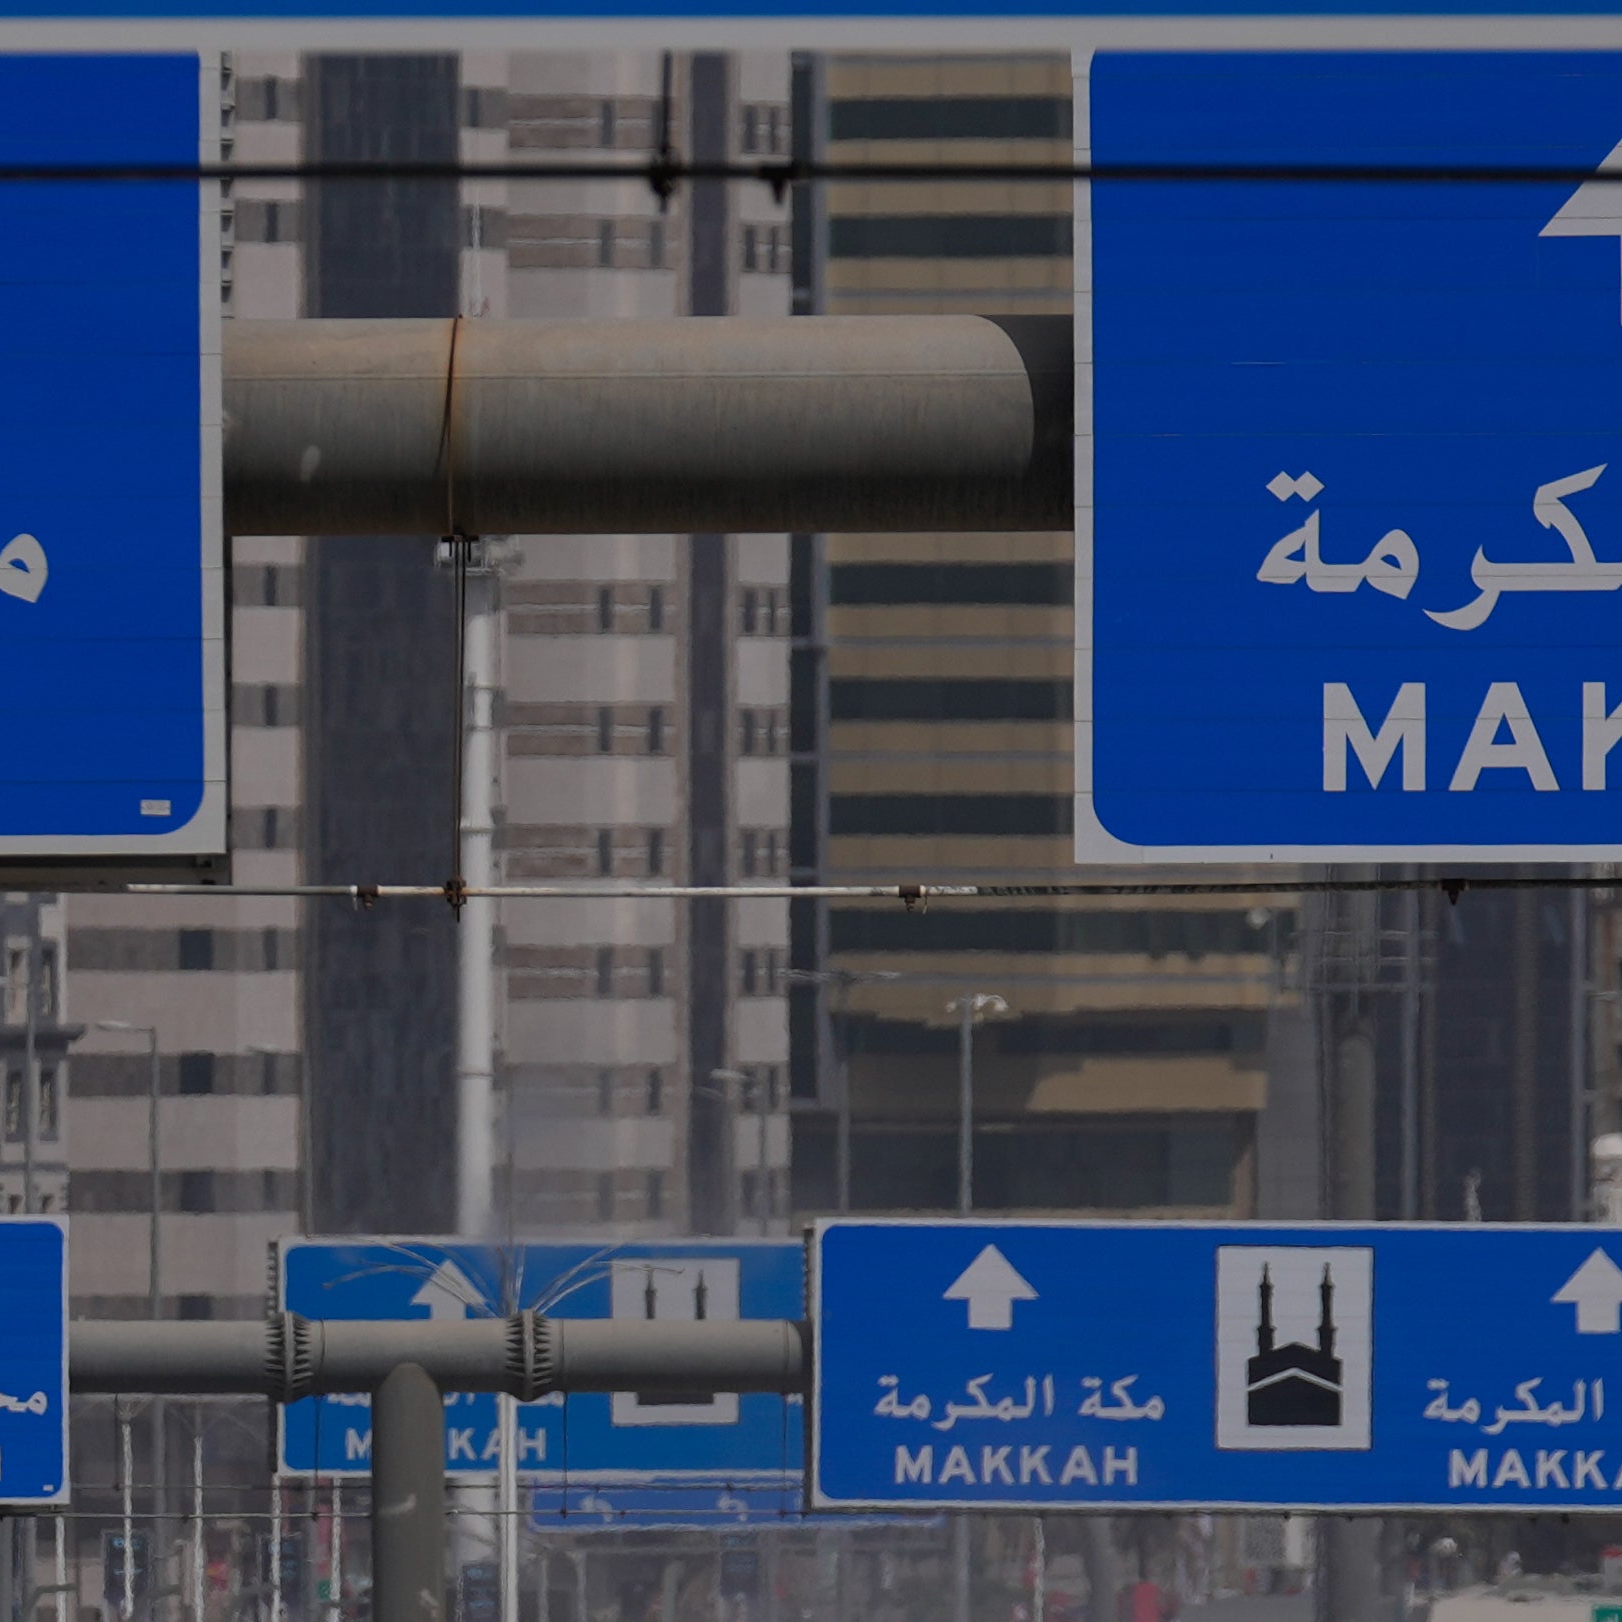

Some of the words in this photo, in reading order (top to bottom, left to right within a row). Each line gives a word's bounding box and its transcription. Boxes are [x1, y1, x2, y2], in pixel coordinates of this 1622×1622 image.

[875, 1375, 1053, 1430] المكرمة
[1079, 1376, 1164, 1420] مكة
[1424, 1378, 1603, 1434] المكرمة
[896, 1446, 1137, 1485] MAKKAH
